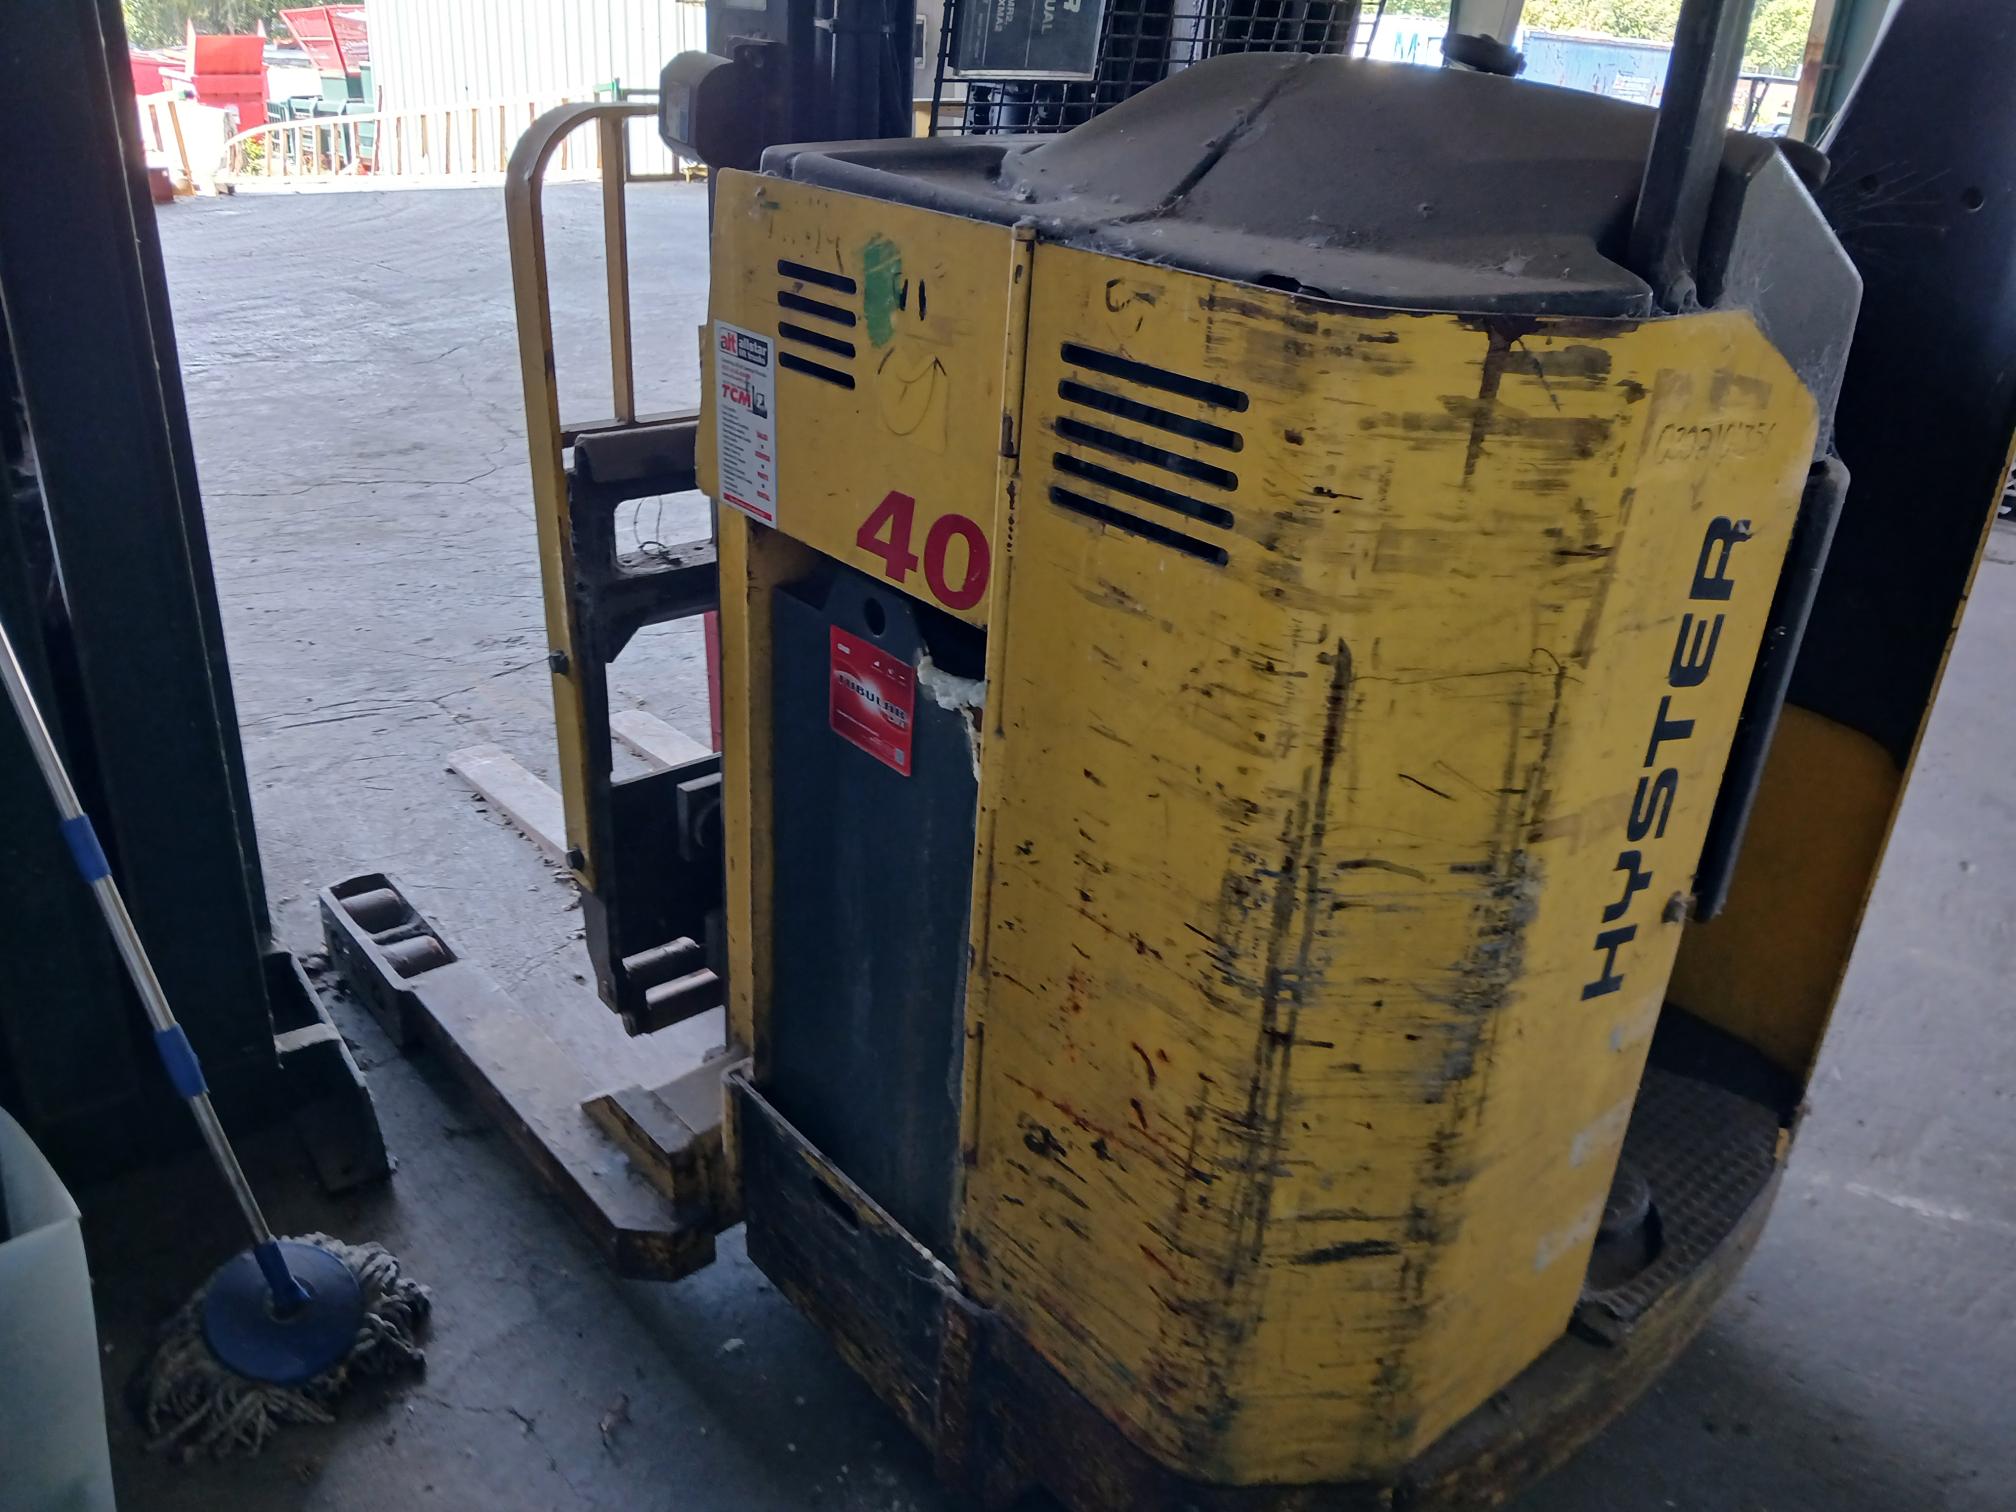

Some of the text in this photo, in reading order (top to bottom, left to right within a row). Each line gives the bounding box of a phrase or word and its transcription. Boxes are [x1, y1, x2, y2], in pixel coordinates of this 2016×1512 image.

[722, 384, 751, 408] TCM
[856, 490, 990, 611] 40
[1580, 515, 1752, 1001] HYSTER
